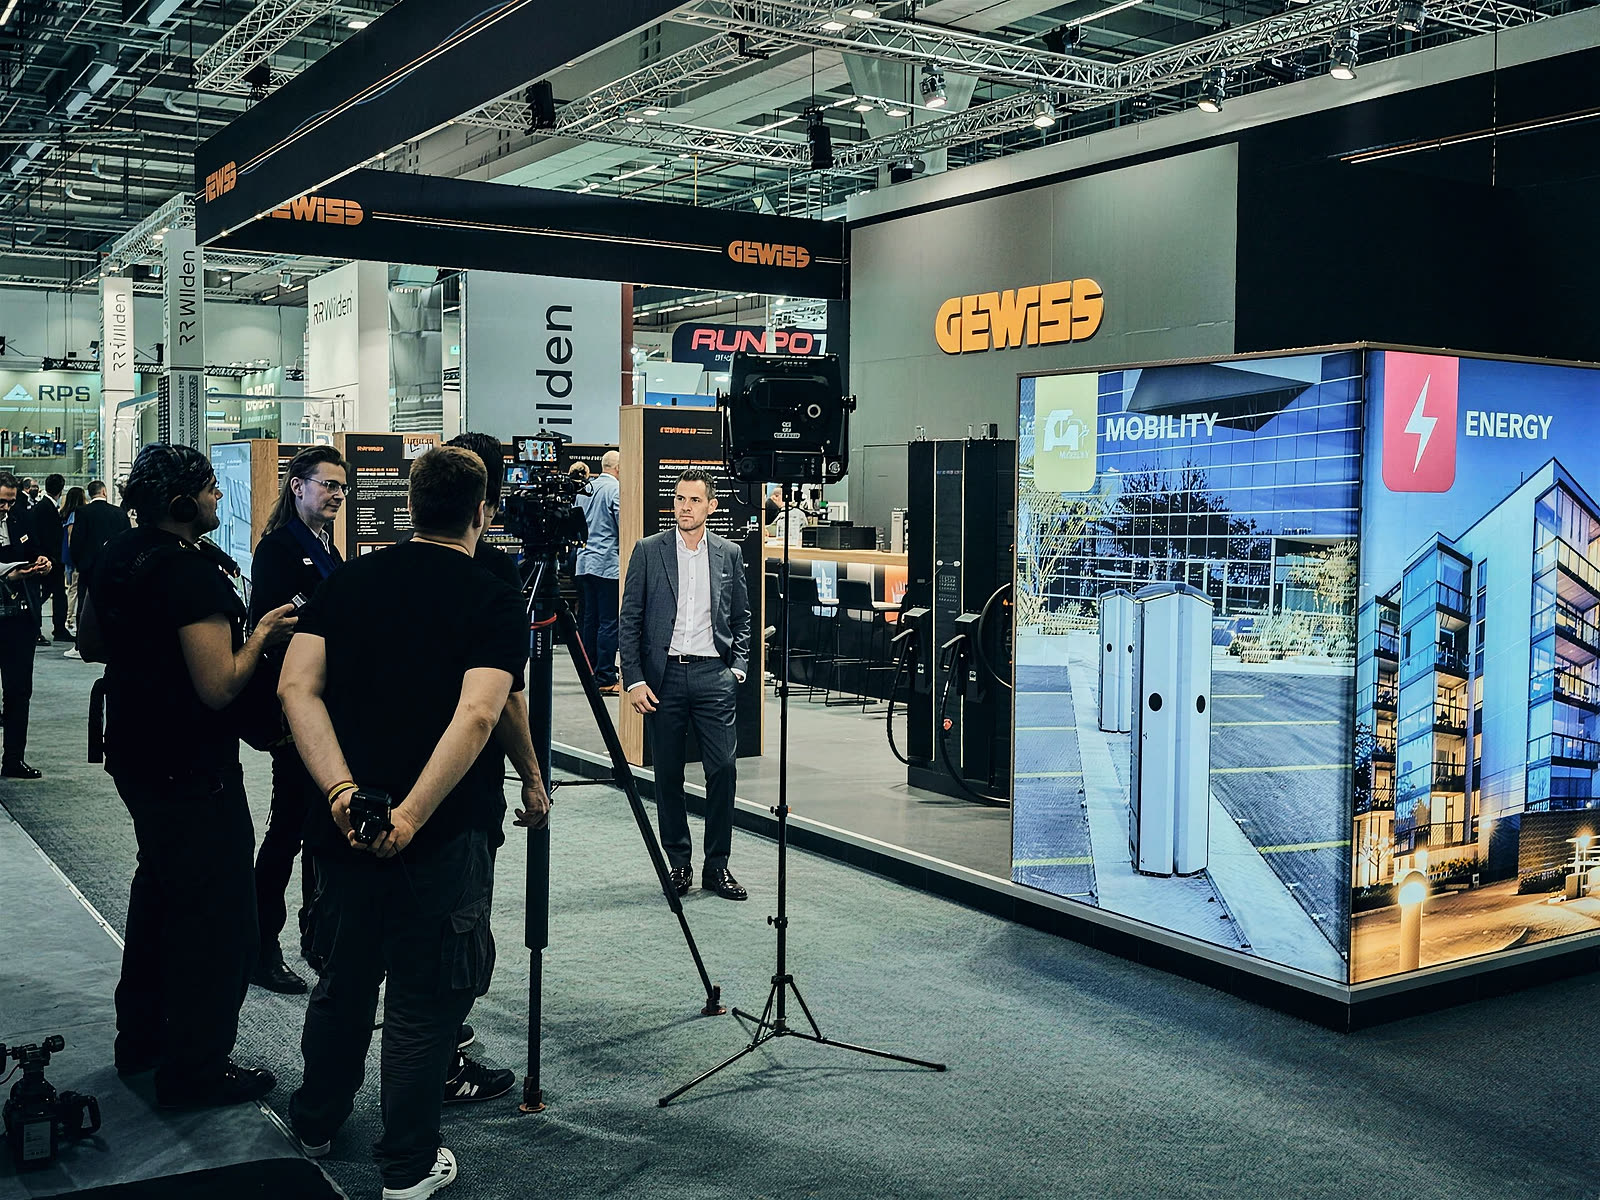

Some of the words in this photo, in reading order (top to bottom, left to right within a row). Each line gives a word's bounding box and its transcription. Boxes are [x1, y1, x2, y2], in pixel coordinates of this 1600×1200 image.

[38, 384, 91, 402] RPS
[1105, 412, 1220, 442] MOBILITY
[1465, 410, 1553, 440] ENERGY
